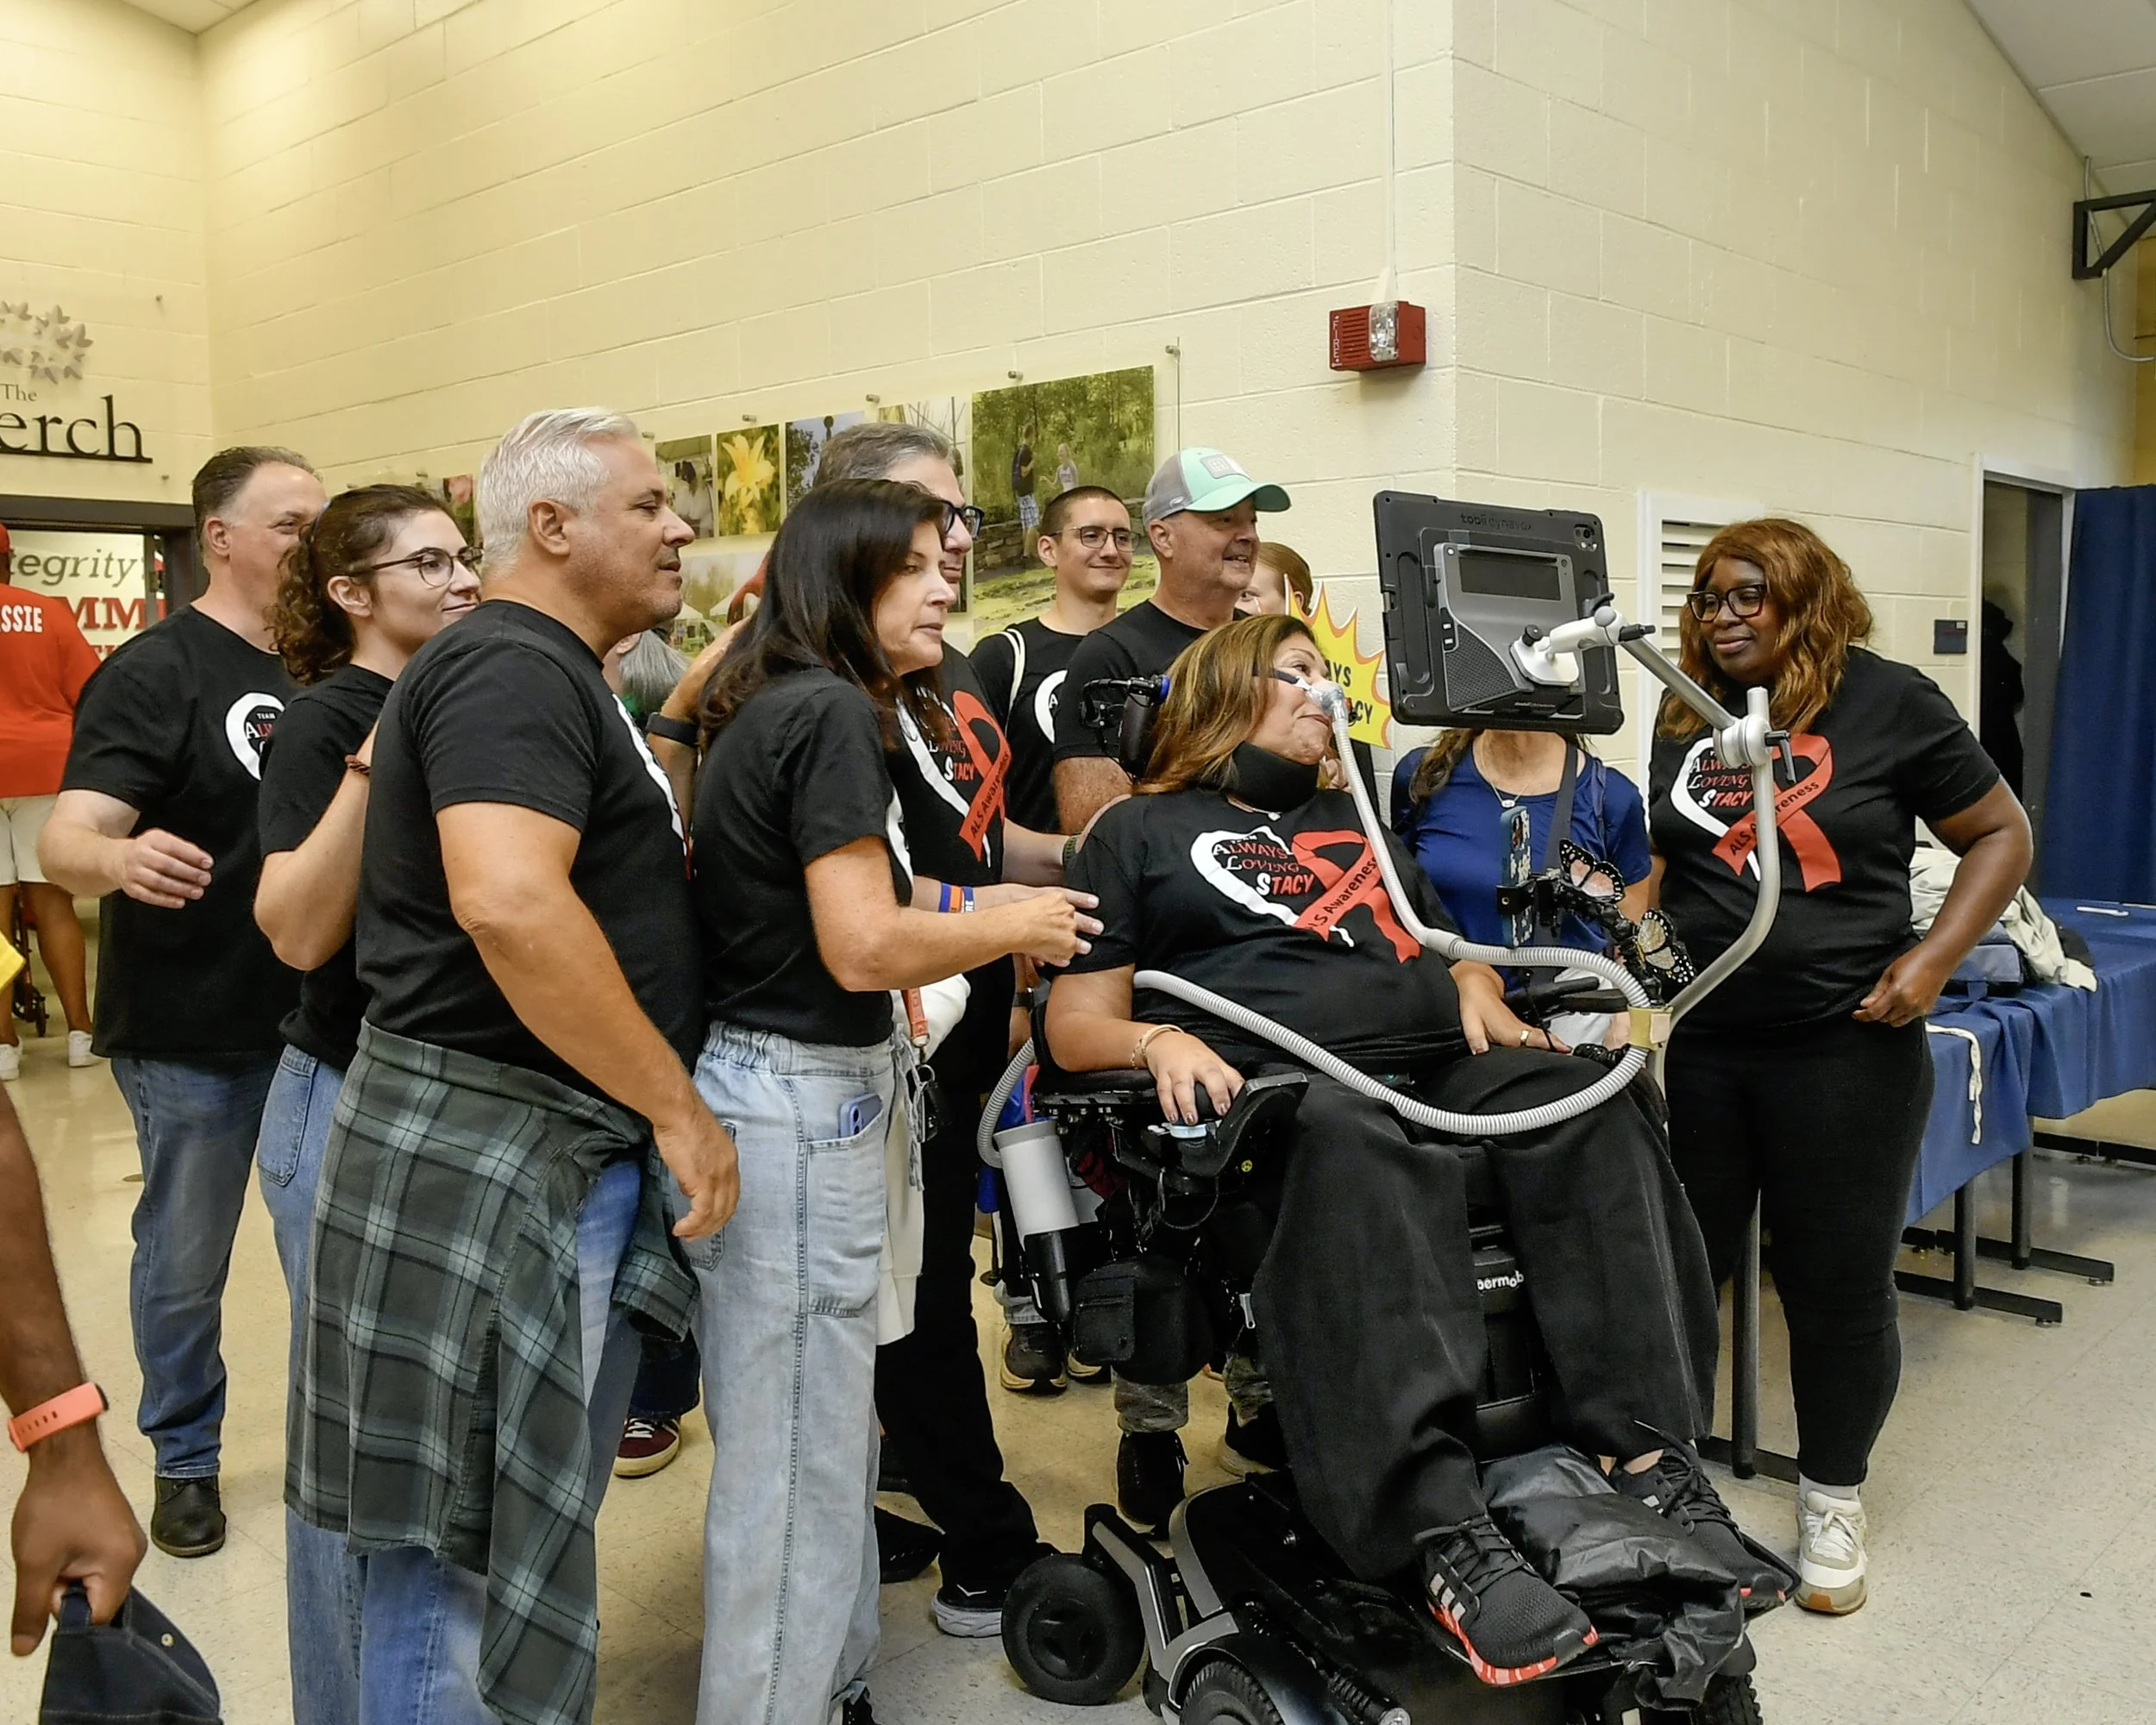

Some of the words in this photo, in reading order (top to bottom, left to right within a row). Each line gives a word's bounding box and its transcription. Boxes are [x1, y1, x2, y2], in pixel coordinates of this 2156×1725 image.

[1, 383, 37, 402] The
[1, 604, 43, 632] SSIE
[943, 755, 975, 781] STACY
[1698, 788, 1753, 808] STACY
[1729, 831, 1752, 856] ALS
[1749, 781, 1820, 835] Areness
[1213, 843, 1288, 860] ALWAYS
[1225, 856, 1300, 873] LOVING
[1256, 872, 1314, 896] STACY
[1306, 914, 1329, 930] LS
